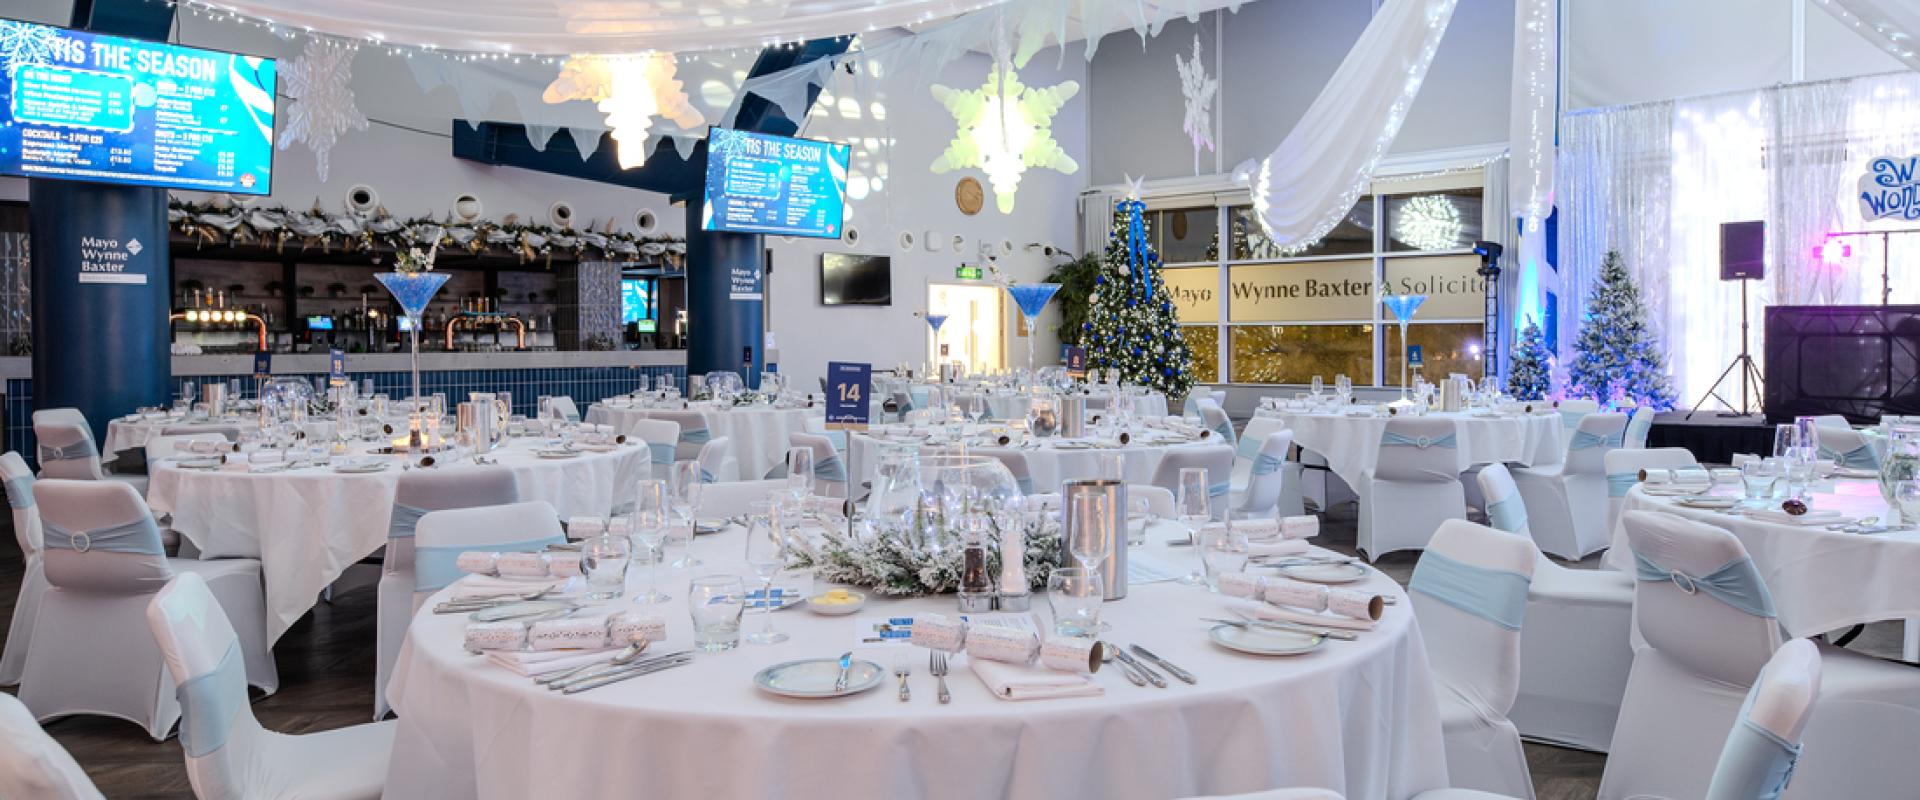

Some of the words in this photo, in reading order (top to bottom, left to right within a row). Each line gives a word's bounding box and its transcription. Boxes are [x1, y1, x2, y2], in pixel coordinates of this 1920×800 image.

[91, 42, 131, 70] THE
[137, 49, 216, 82] SEASON
[764, 140, 782, 158] THE
[783, 143, 821, 162] SEASON
[81, 237, 118, 250] Mayo
[81, 249, 128, 262] Wynne
[81, 261, 125, 272] Baxter
[731, 268, 751, 277] Mayo
[1166, 285, 1212, 307] Mayo
[1232, 281, 1299, 304] Wynne
[1305, 279, 1372, 298] Baxter
[838, 383, 861, 401] 14
